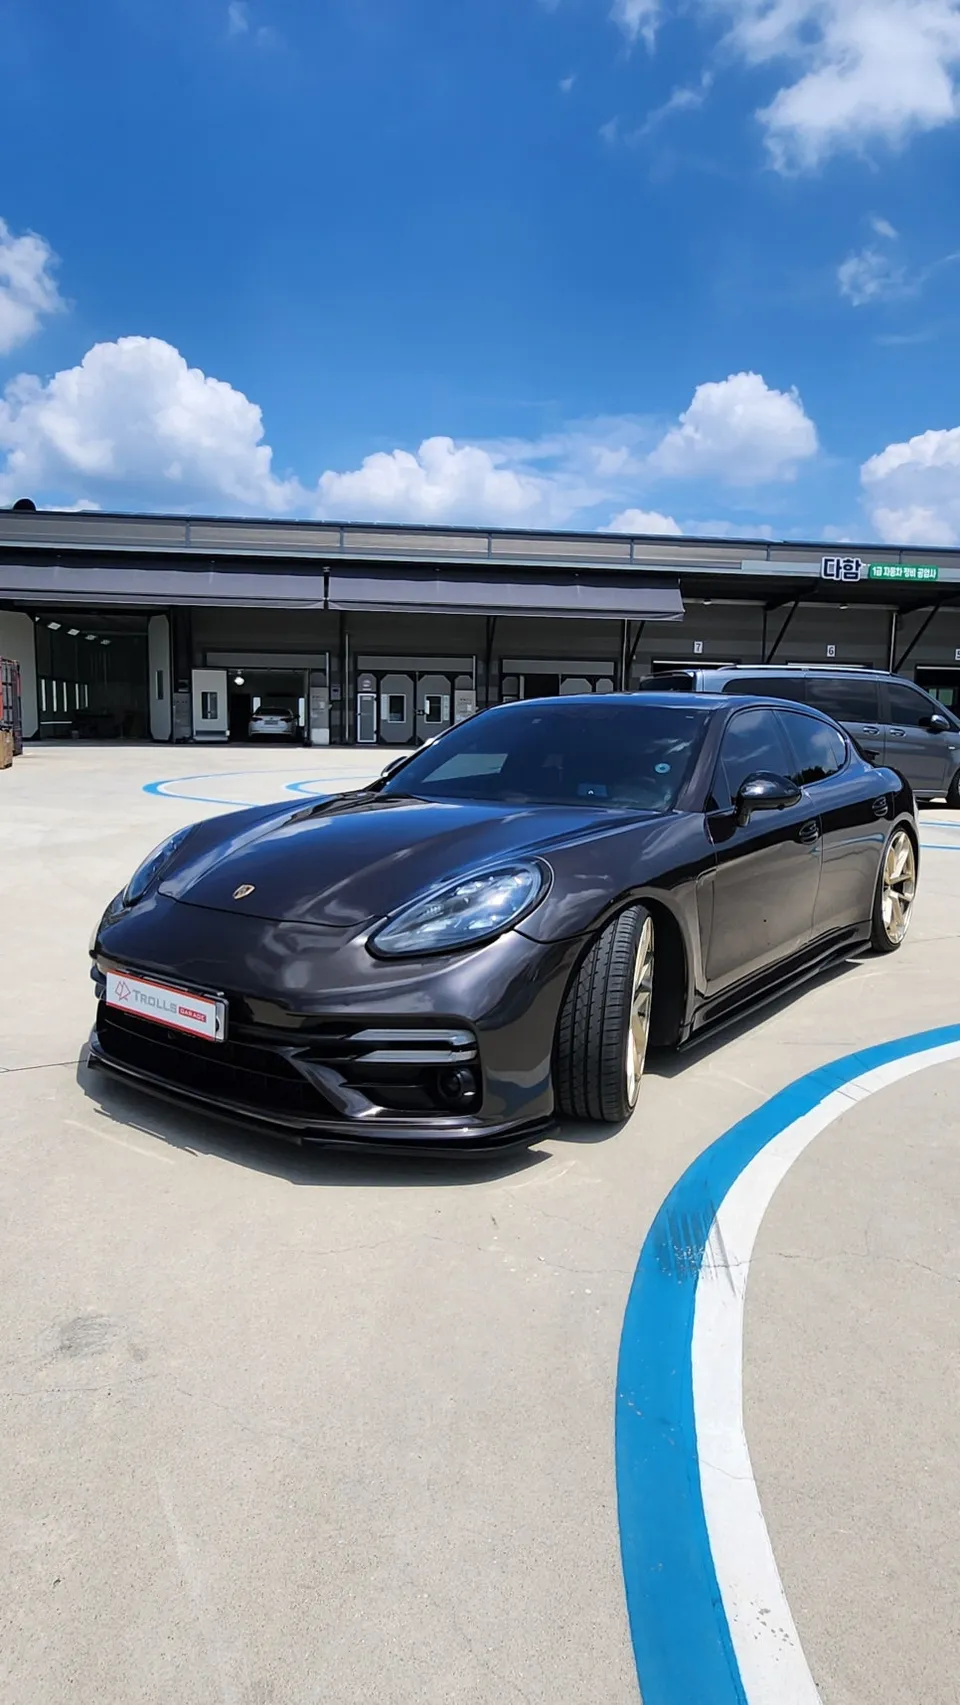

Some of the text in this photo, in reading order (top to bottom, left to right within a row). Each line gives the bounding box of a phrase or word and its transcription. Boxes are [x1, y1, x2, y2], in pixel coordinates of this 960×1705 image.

[822, 557, 862, 580] 다함
[872, 566, 883, 577] 1급
[883, 566, 903, 578] 자동차
[132, 989, 206, 1022] TROLLS GARAGE
